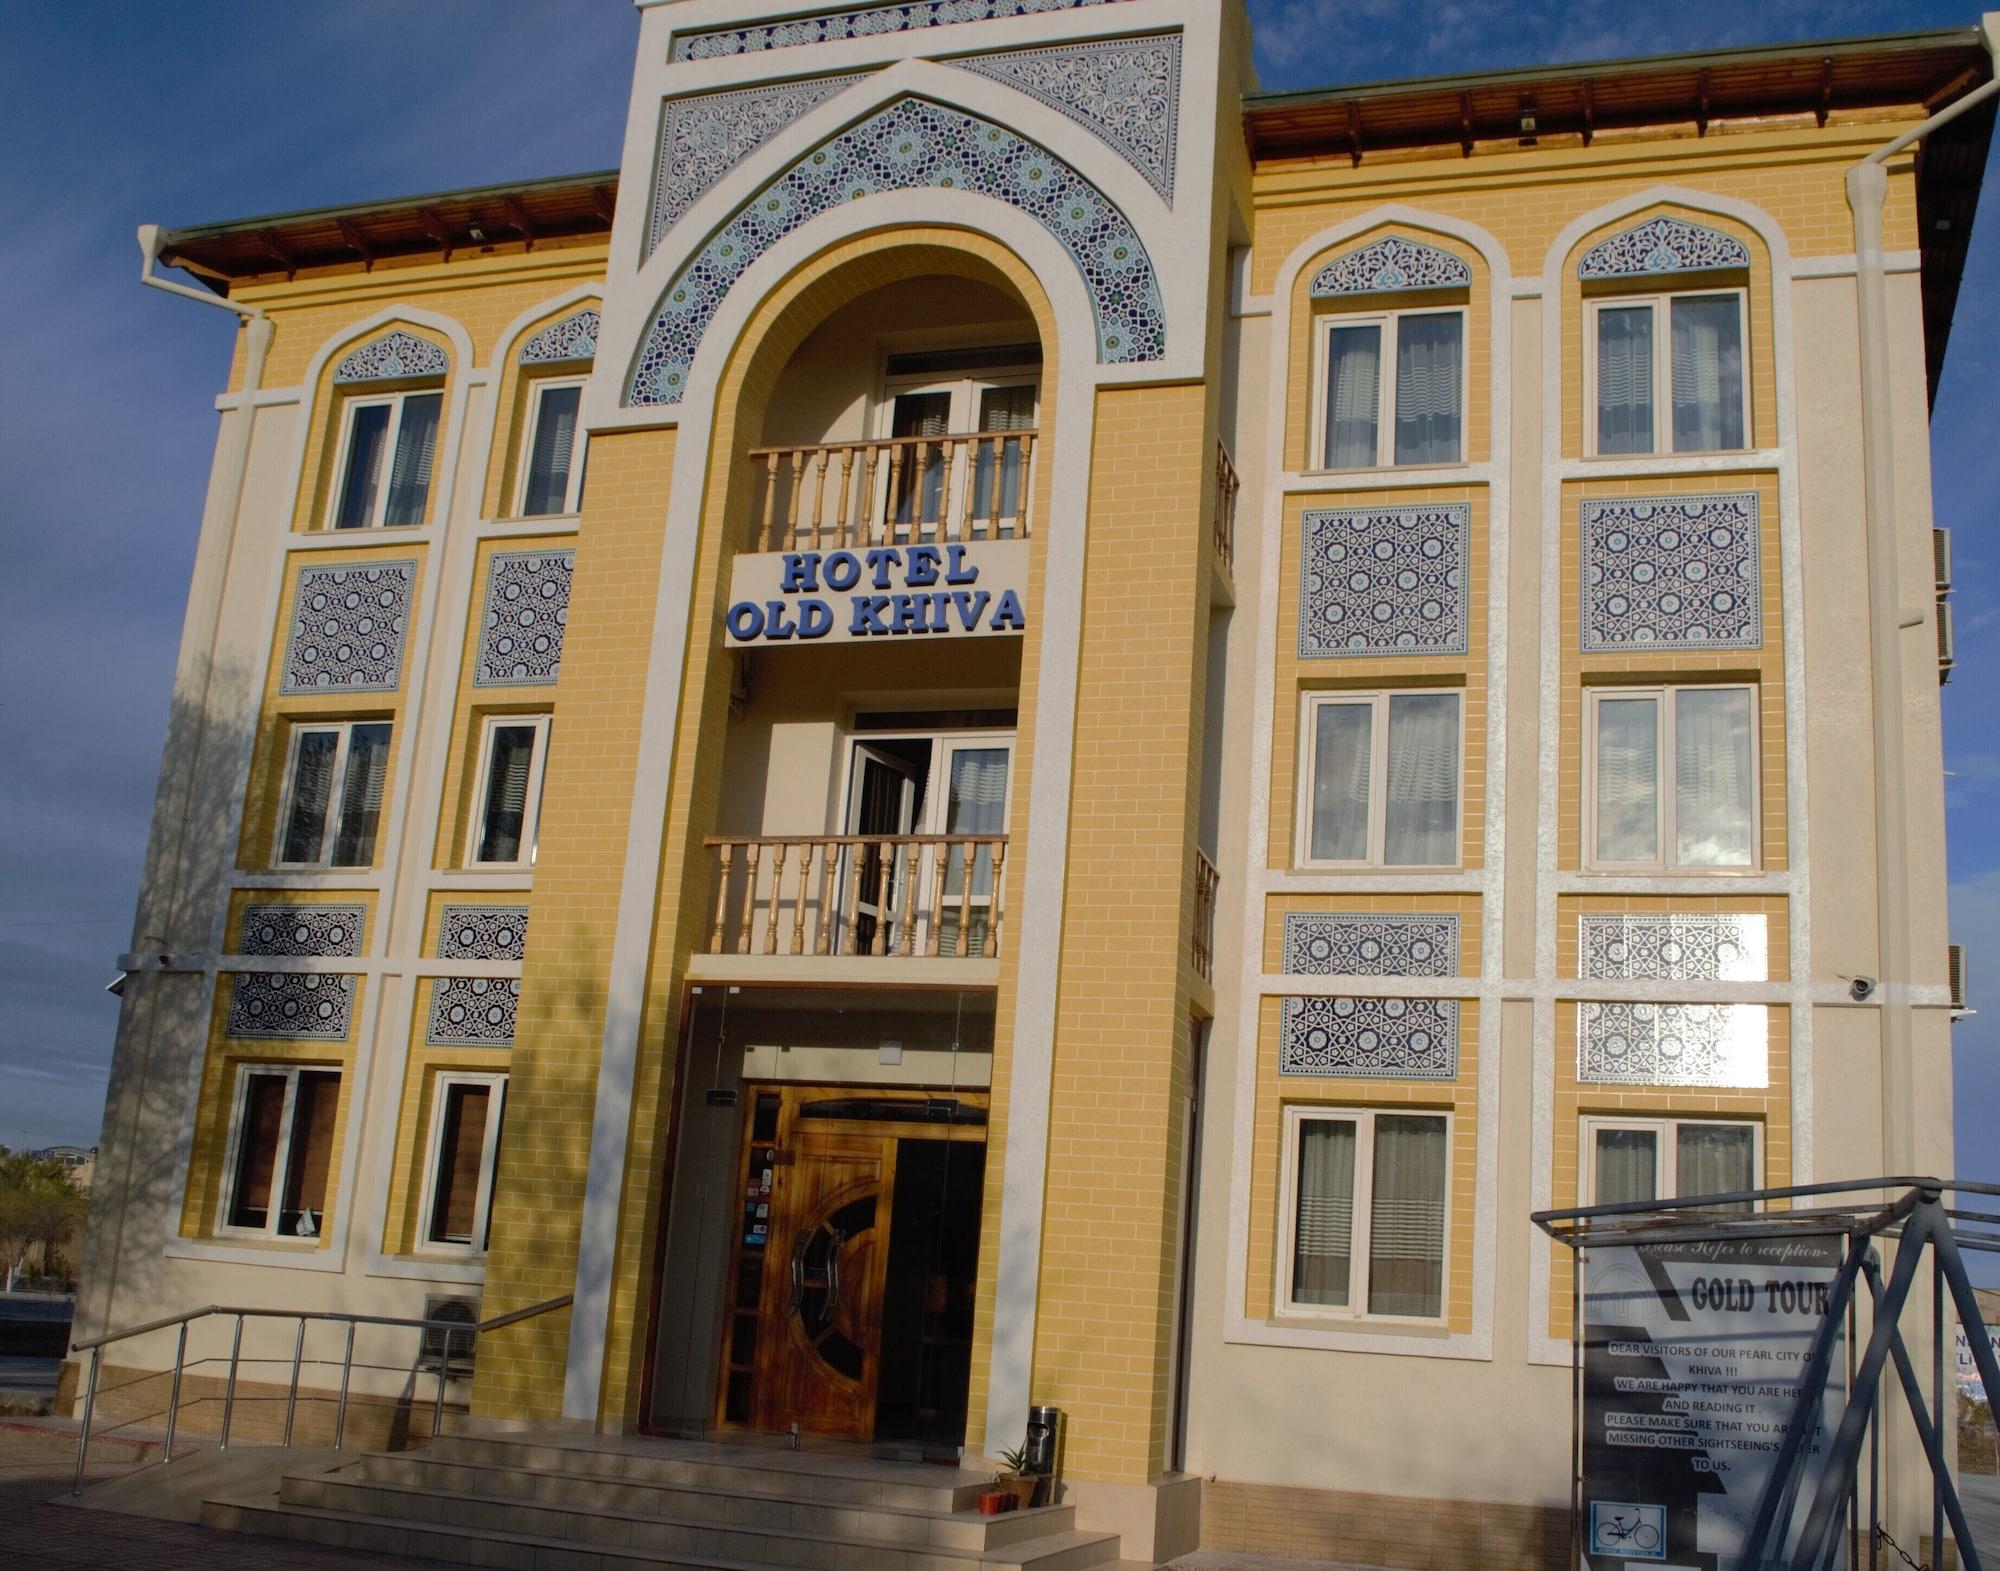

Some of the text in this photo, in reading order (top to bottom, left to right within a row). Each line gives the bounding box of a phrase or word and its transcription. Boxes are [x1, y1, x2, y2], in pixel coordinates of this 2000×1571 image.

[780, 545, 979, 593] HOTEL
[727, 588, 1025, 641] OLD KHIVA
[1739, 1241, 1753, 1256] to
[1692, 1277, 1829, 1316] GOLD TOUR
[1610, 1343, 1640, 1354] DEAR
[1642, 1345, 1691, 1356] VISITORS
[1694, 1347, 1708, 1357] OF
[1711, 1348, 1736, 1358] OUR
[1739, 1349, 1774, 1360] PEARL
[1776, 1351, 1800, 1361] CITY
[1688, 1365, 1738, 1376] KHIVA !!!
[1616, 1379, 1637, 1389] WE
[1637, 1380, 1659, 1391] ARE
[1662, 1381, 1698, 1392] HAPPY
[1701, 1383, 1728, 1394] THAT
[1731, 1385, 1755, 1396] YOU
[1758, 1387, 1780, 1397] ARE
[1665, 1400, 1690, 1410] AND
[1692, 1401, 1743, 1413] READING
[1746, 1404, 1756, 1414] IT
[1607, 1415, 1789, 1434] PLEASE MAKE SURE THAT YOU AR
[1608, 1433, 1656, 1444] MISSING
[1658, 1435, 1695, 1446] OTHER
[1695, 1459, 1731, 1471] TO US.
